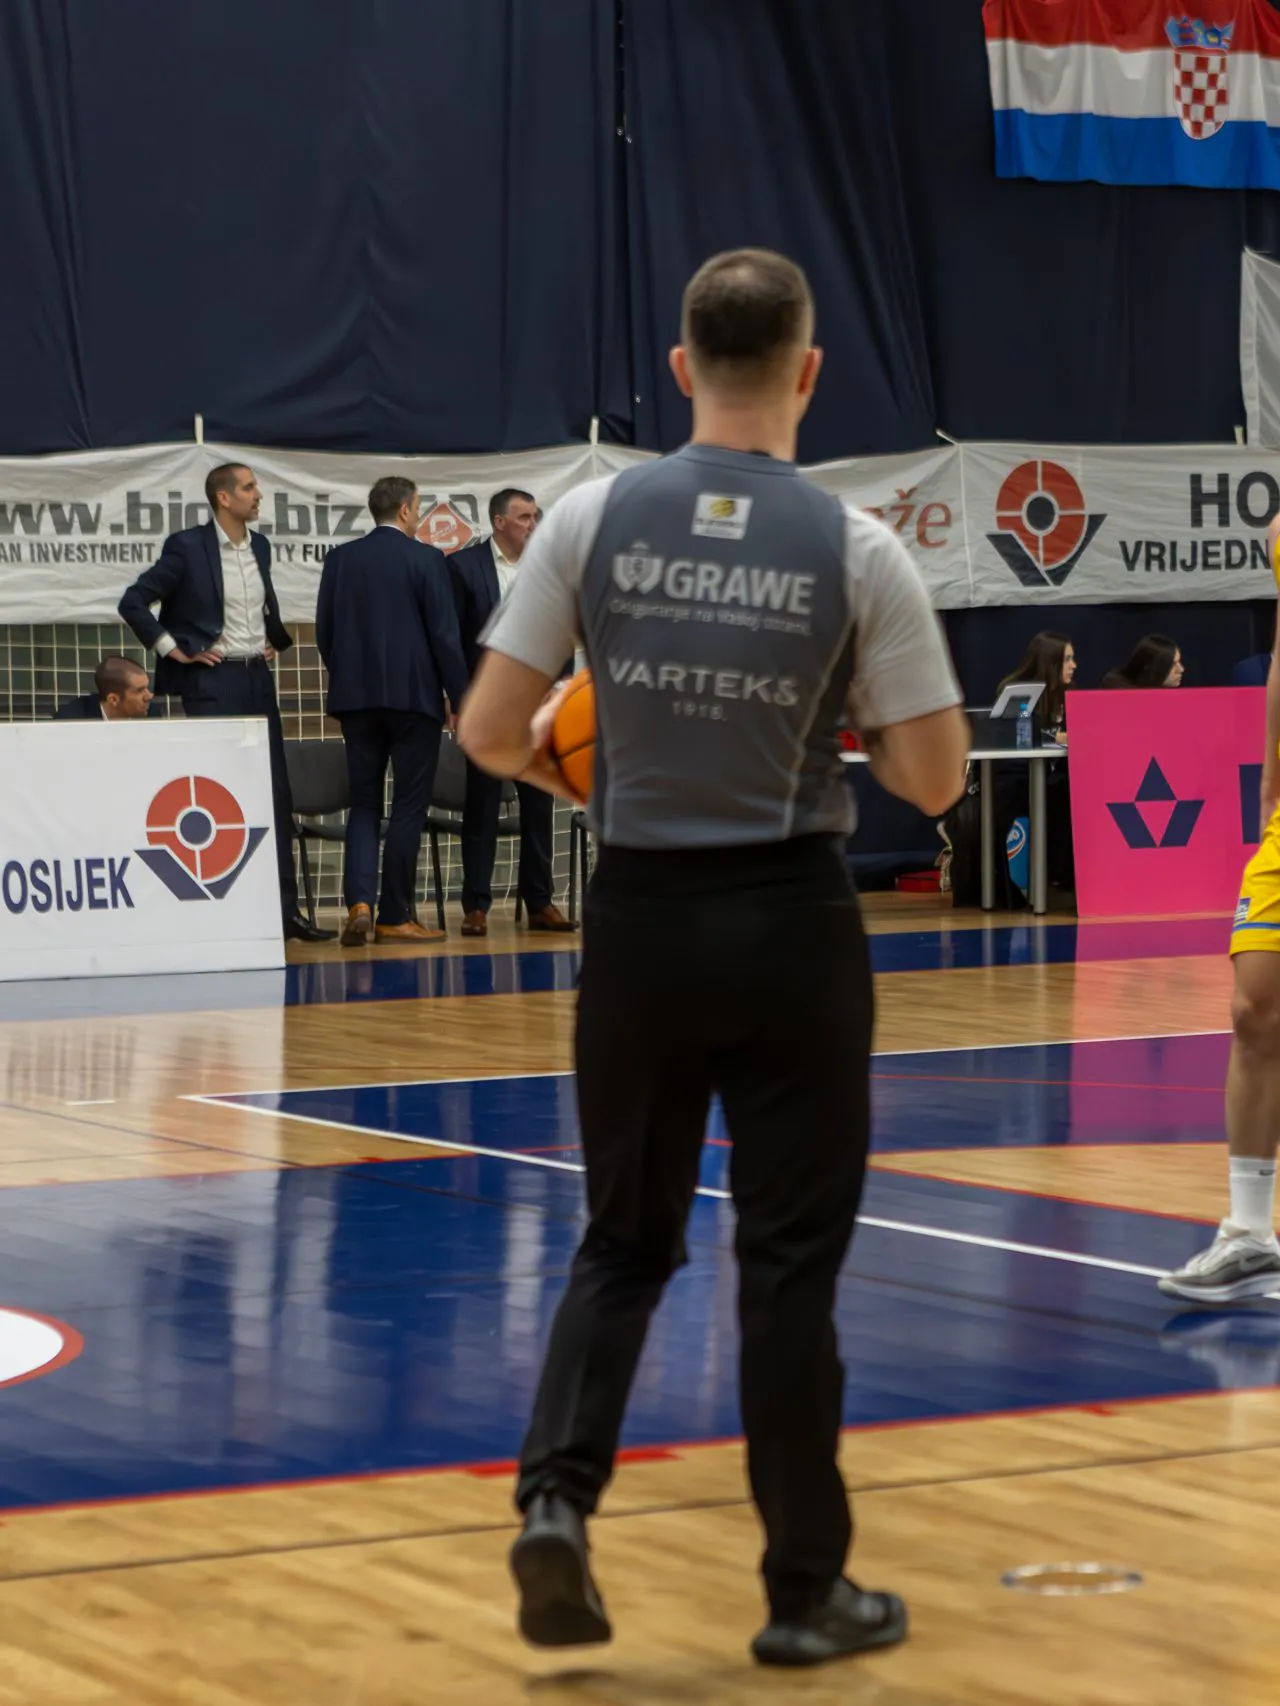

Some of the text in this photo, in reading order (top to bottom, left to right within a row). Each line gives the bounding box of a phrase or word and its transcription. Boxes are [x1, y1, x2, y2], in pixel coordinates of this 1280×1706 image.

[30, 542, 156, 564] INVESTMENT
[664, 559, 817, 616] GRAWE
[607, 656, 800, 708] VARTEKS
[2, 856, 136, 914] OSIJEK
